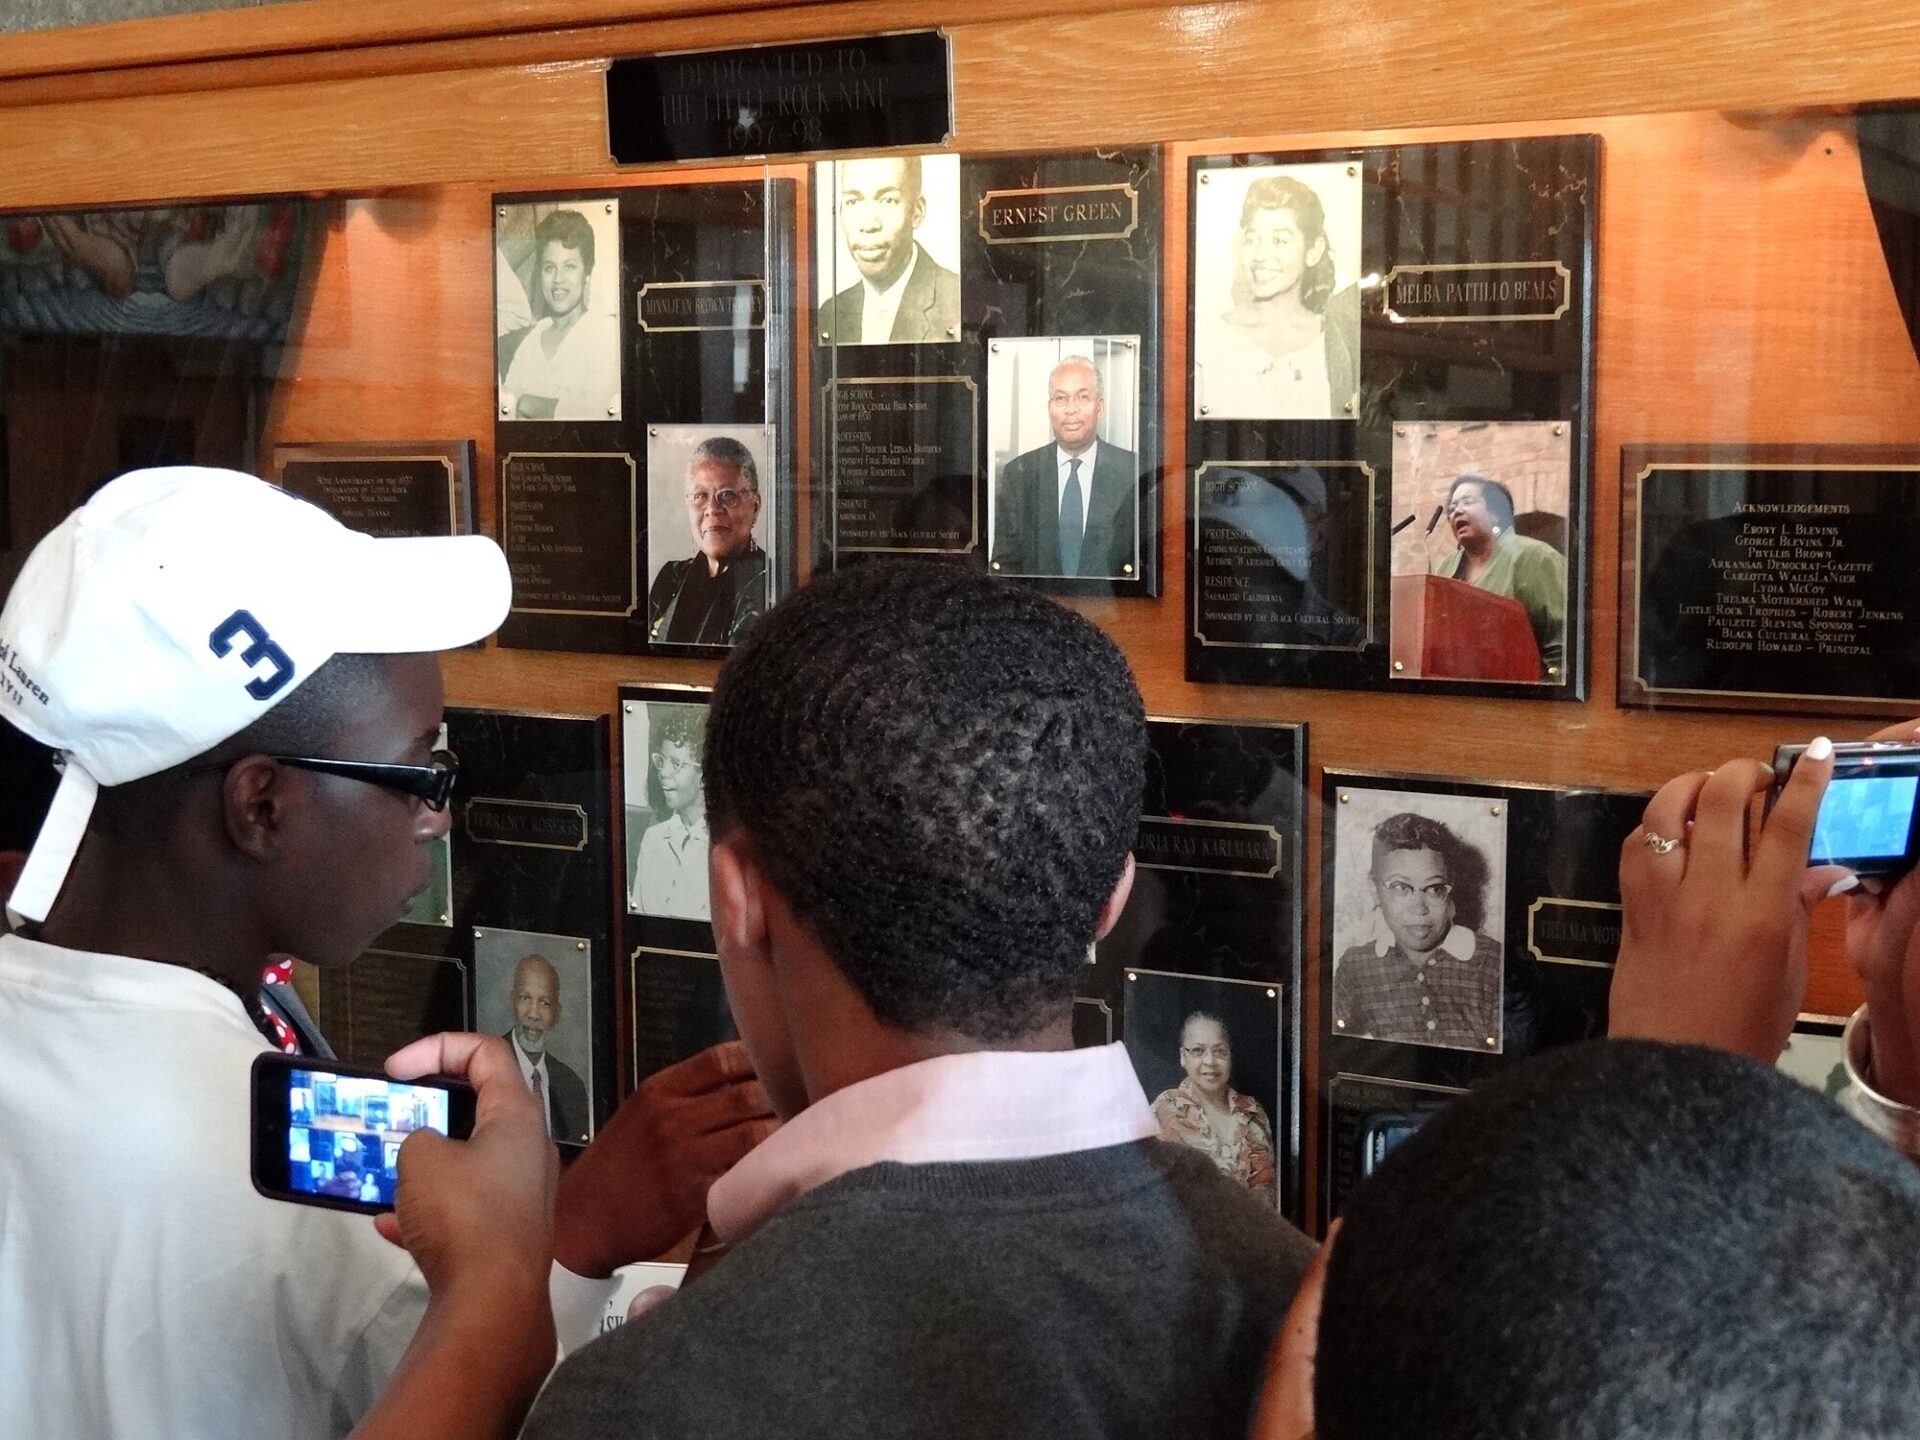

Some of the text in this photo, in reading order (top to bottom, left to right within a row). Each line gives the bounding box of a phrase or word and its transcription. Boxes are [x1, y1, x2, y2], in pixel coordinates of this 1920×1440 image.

[837, 47, 866, 73] TO
[778, 82, 830, 117] ROCK
[839, 77, 890, 111] NINE
[992, 202, 1123, 226] ERNEST GREEN
[1396, 280, 1557, 304] MELBA PATTILLO BEALS
[1732, 501, 1851, 514] ACKNOWLEDGEMENTS
[1743, 523, 1777, 534] EBONY
[1795, 523, 1839, 535] BLEVINS
[1735, 534, 1776, 546] GEORGE
[1780, 535, 1822, 547] BLEVINS
[1795, 547, 1832, 559] BROWN
[1708, 558, 1763, 569] ARKANSAS
[1723, 569, 1775, 582] CARLOTTA
[1752, 582, 1784, 593] LYDIA
[1716, 592, 1757, 604] THELMA
[1679, 603, 1712, 614] LITTLE
[1716, 604, 1743, 615] ROCK
[1748, 605, 1796, 617] TROPHIES
[1812, 607, 1853, 619] ROBERT
[1859, 608, 1904, 621] JENKINS
[1708, 615, 1757, 627] PAULETTE
[1761, 617, 1805, 629] BLEVINS
[1809, 618, 1854, 631] SPONSOR
[1722, 627, 1857, 643] BLACK CULTURAL SOCIETY
[1705, 638, 1753, 650] RUDOLPH
[1757, 640, 1802, 652] HOWARD
[1818, 642, 1872, 655] PRINCIPAL
[209, 609, 295, 701] 3
[9, 651, 49, 705] Lauren
